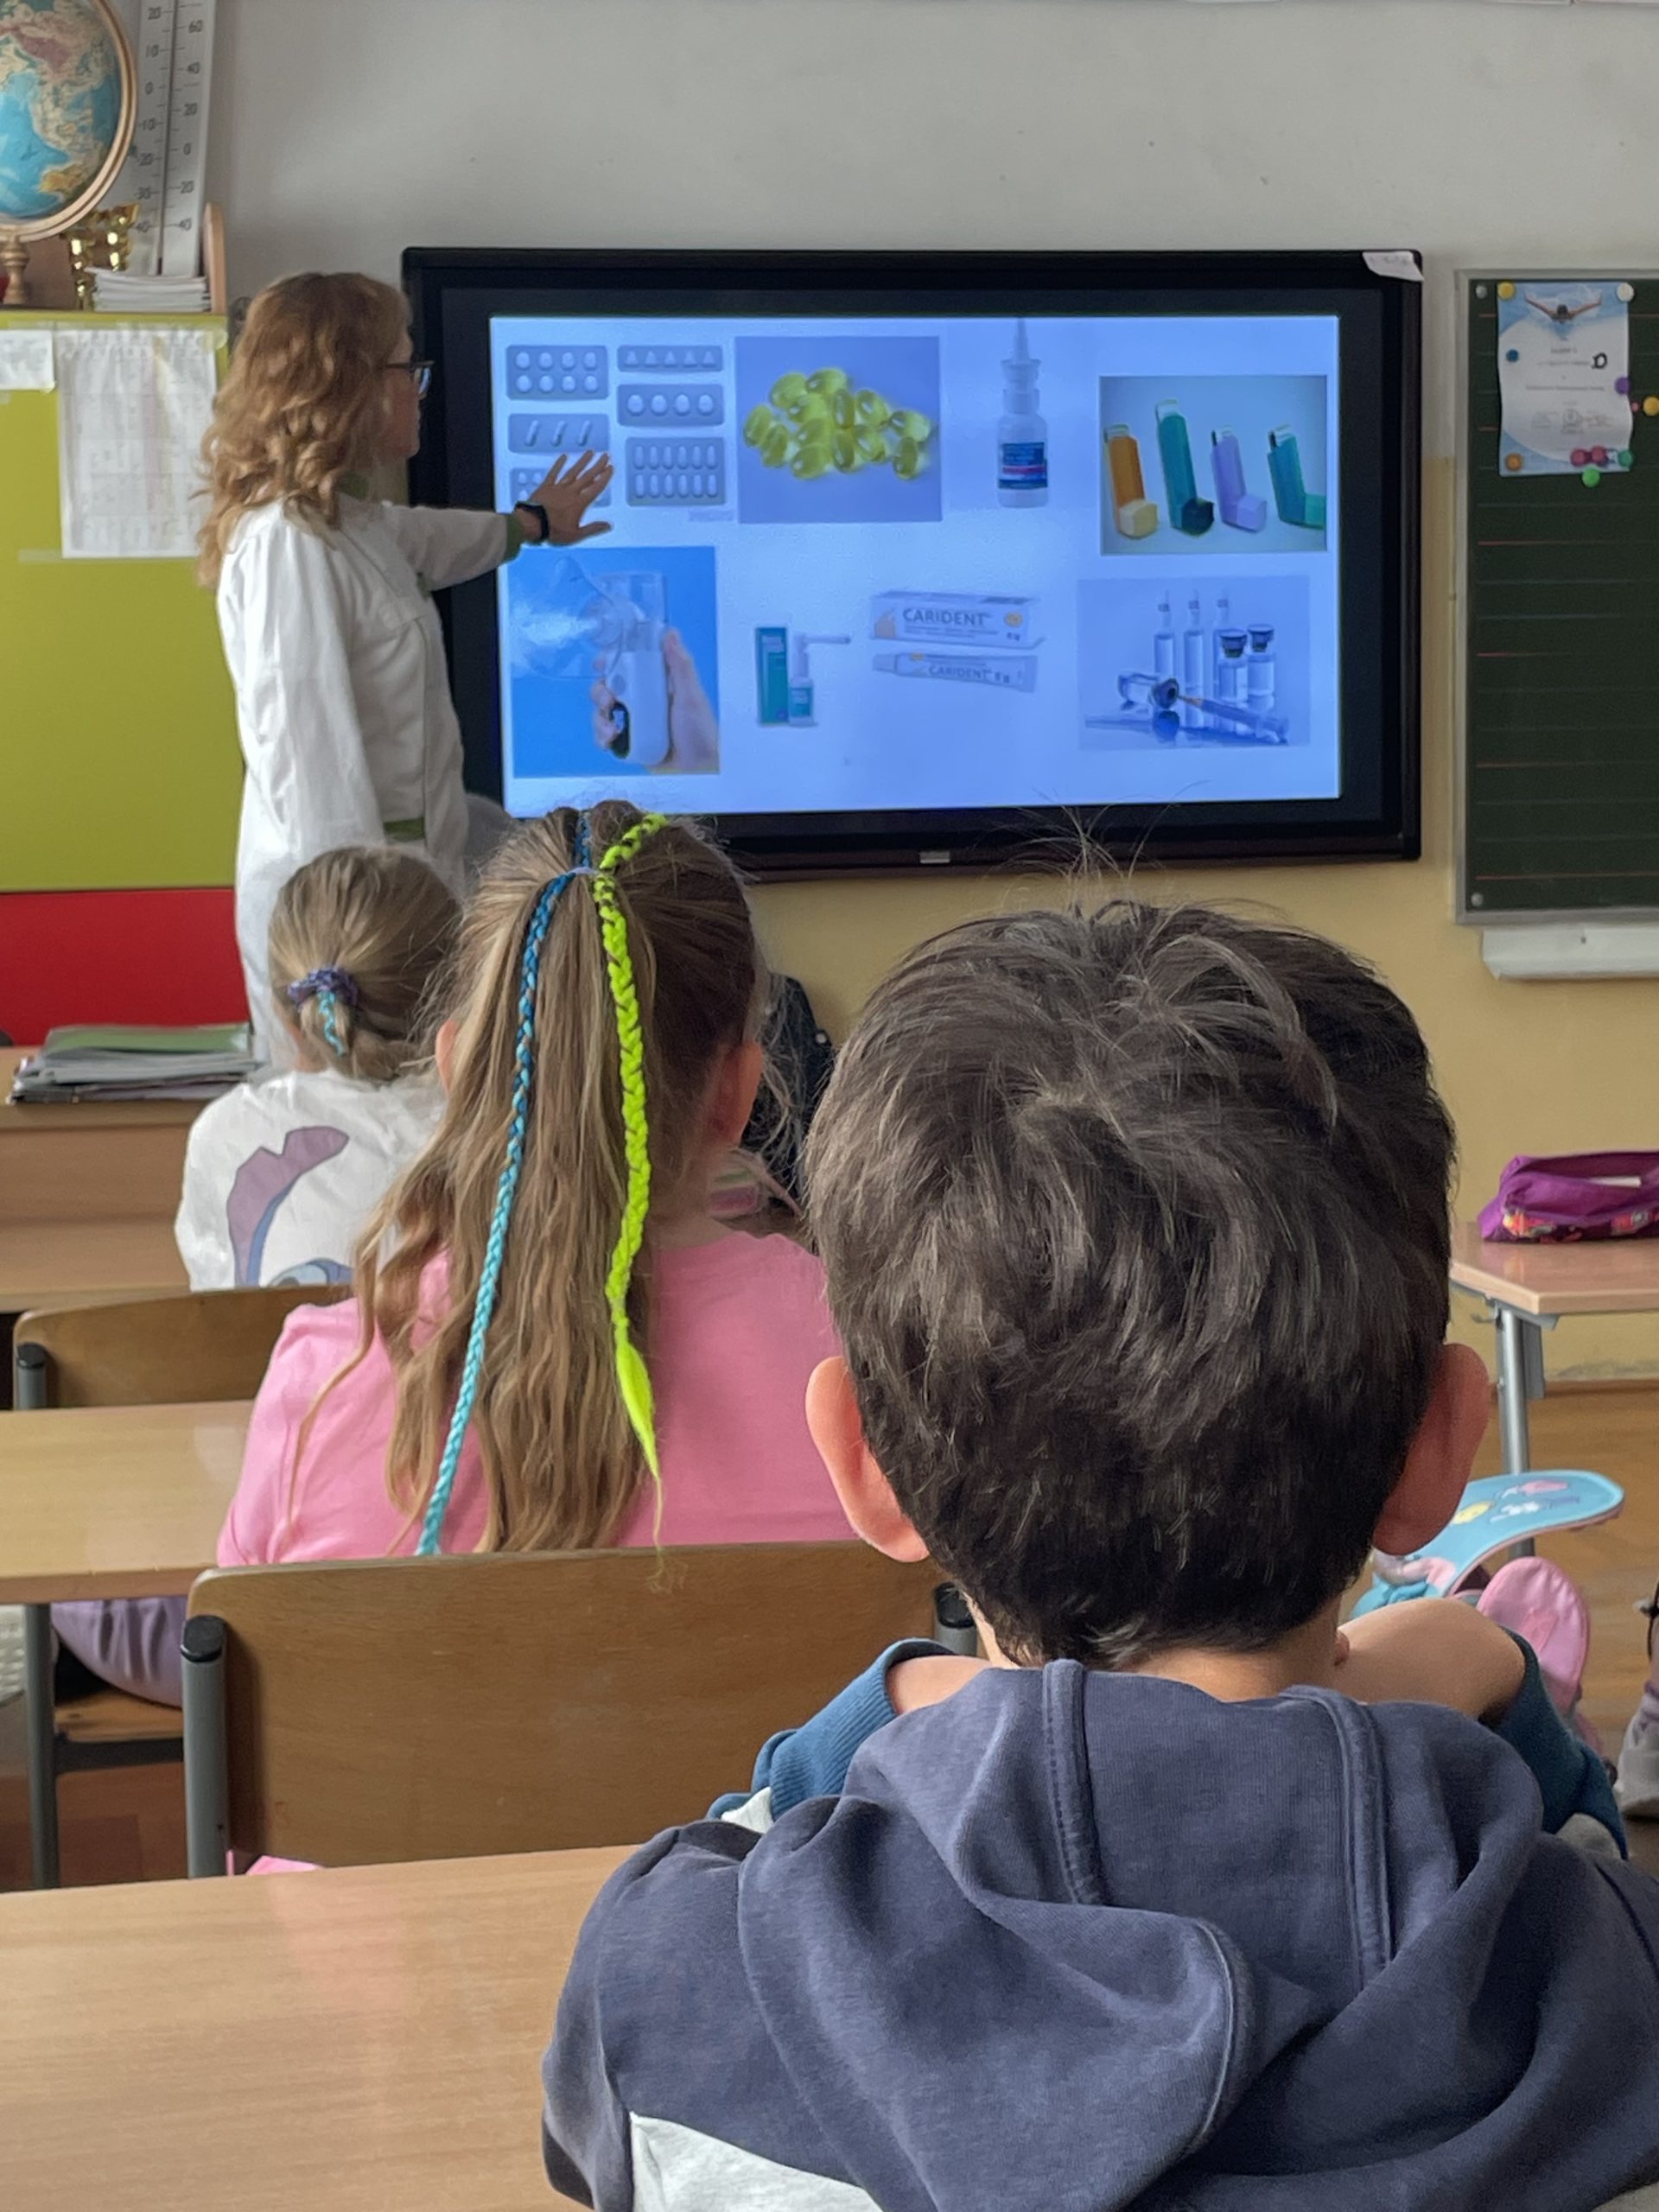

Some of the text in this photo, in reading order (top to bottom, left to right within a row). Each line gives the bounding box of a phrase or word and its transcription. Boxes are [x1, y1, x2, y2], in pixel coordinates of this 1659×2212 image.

[148, 6, 162, 21] 20
[188, 19, 203, 34] 60
[145, 44, 160, 58] 10
[187, 61, 200, 74] 40
[144, 81, 154, 95] 0
[184, 103, 198, 116] 20
[183, 143, 192, 156] 0
[902, 607, 987, 626] CARIDENT
[928, 664, 989, 680] CARIDENT
